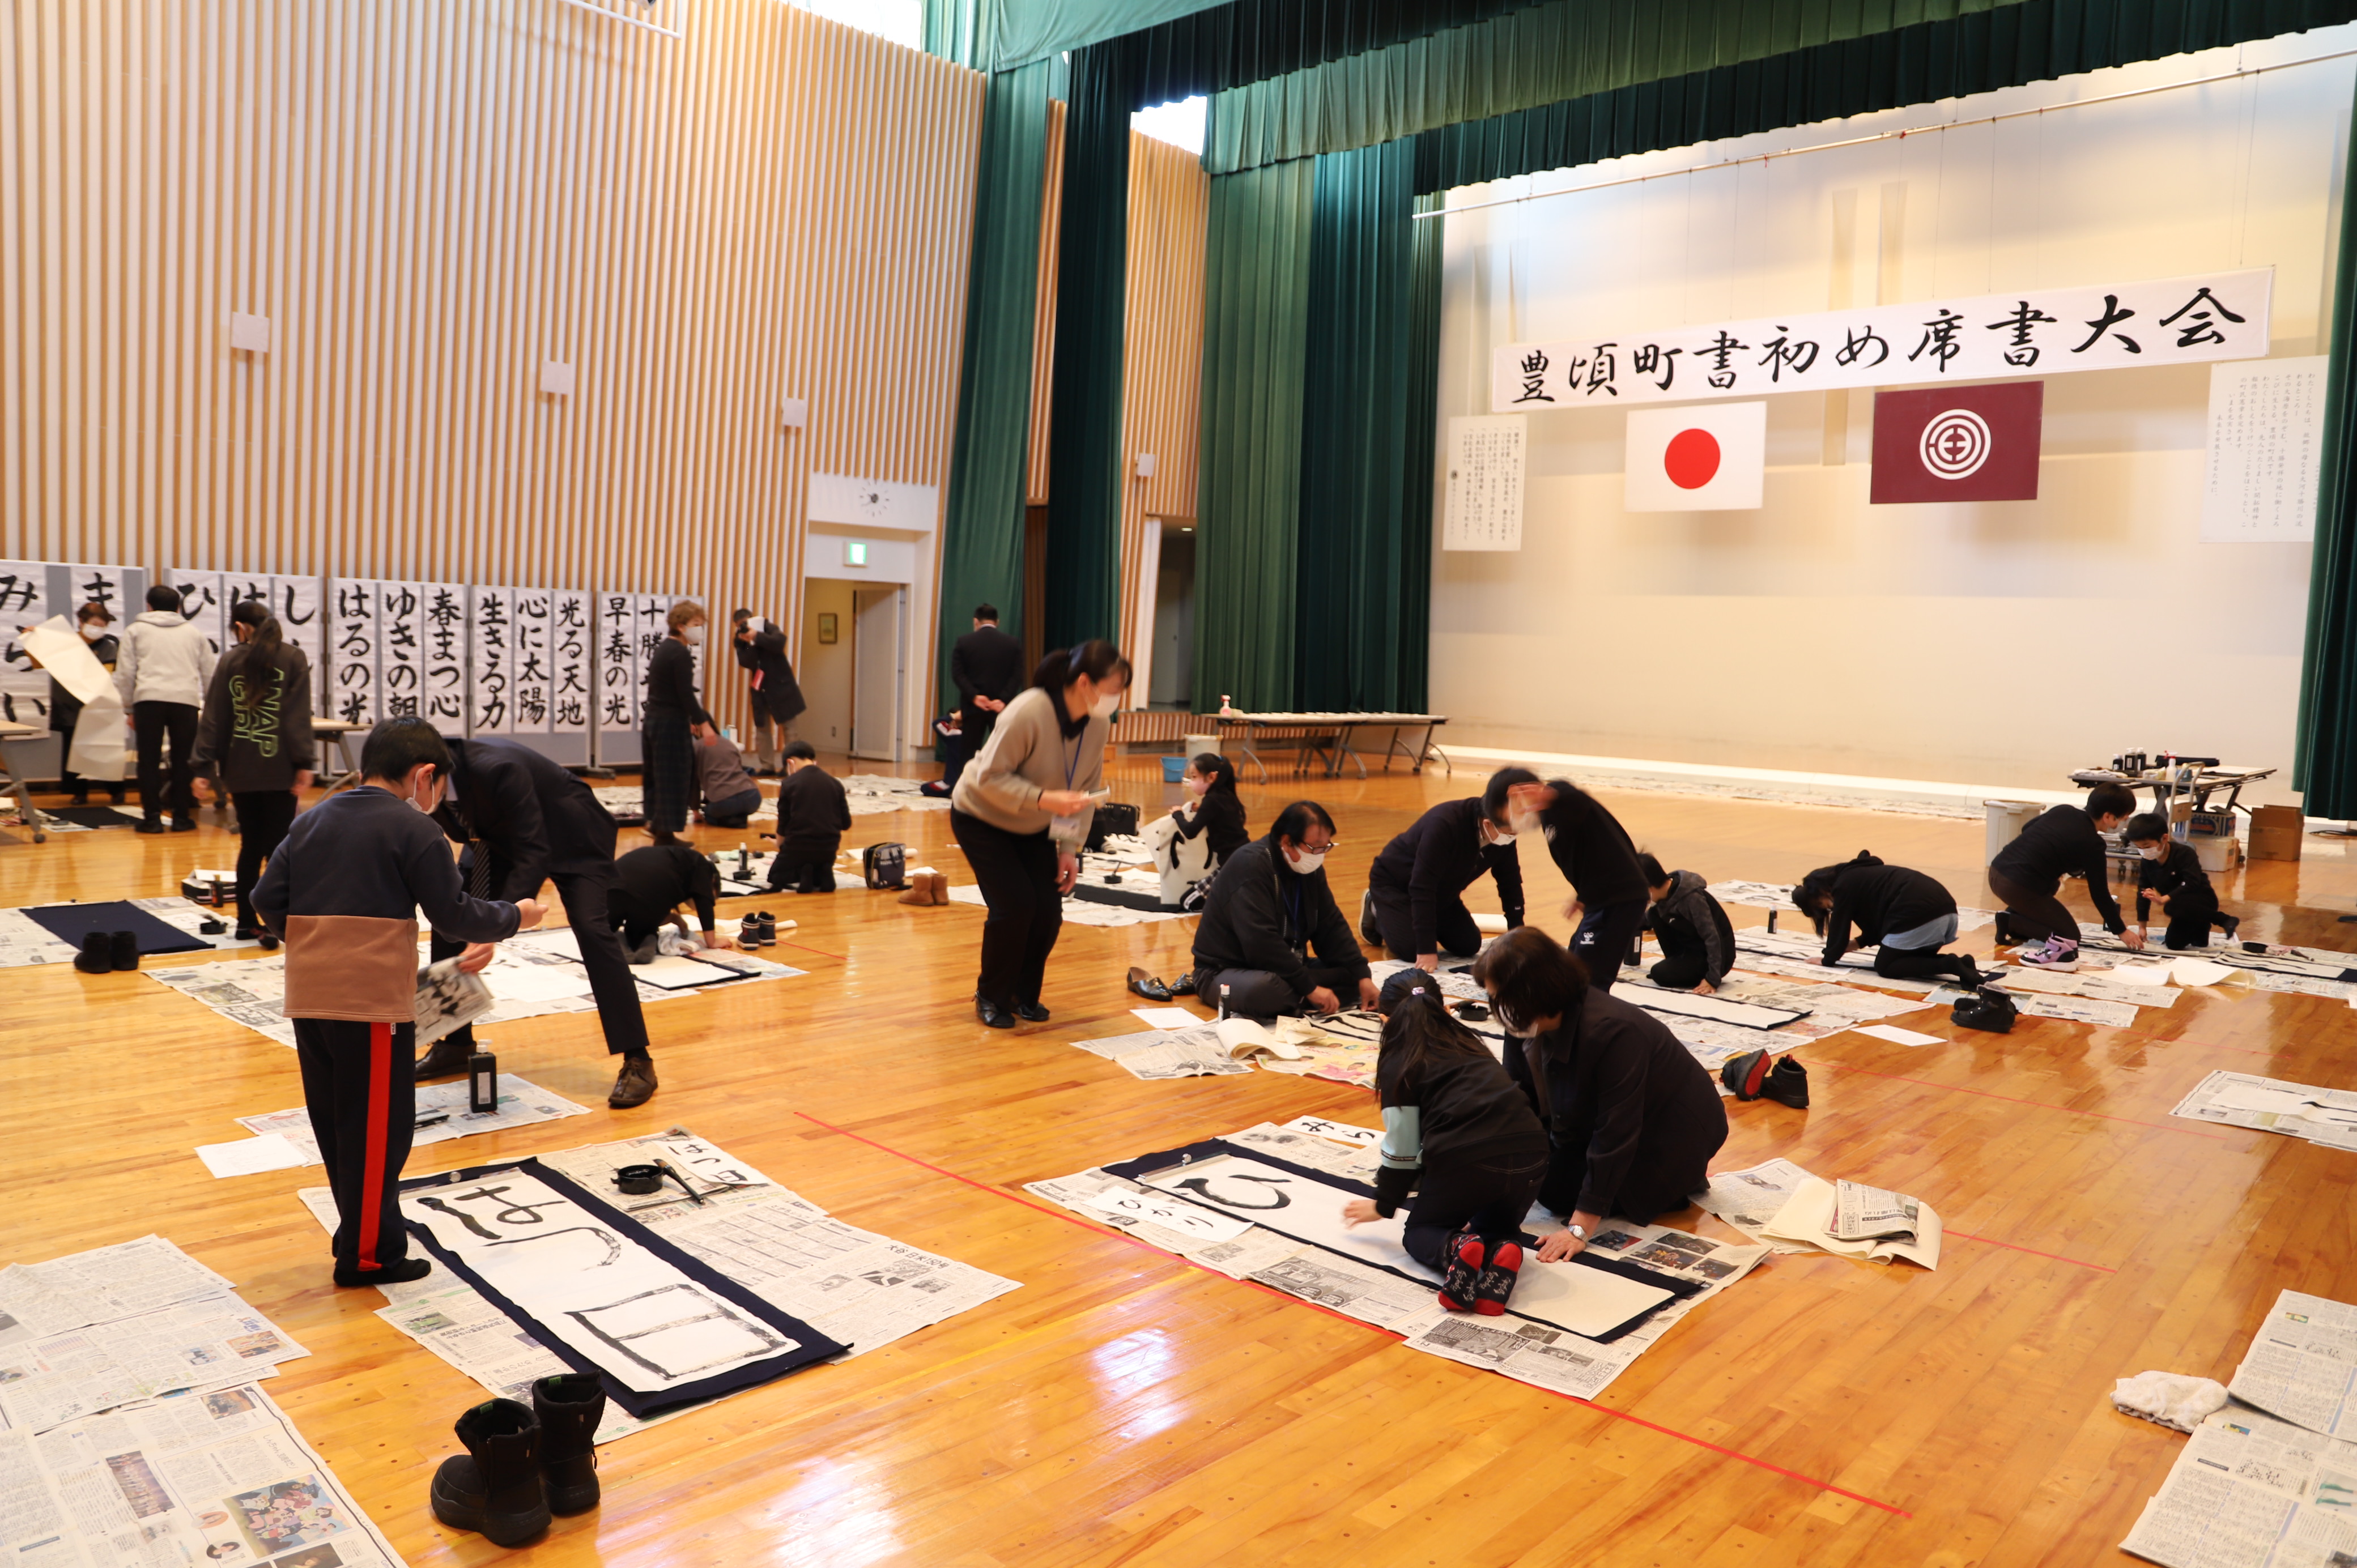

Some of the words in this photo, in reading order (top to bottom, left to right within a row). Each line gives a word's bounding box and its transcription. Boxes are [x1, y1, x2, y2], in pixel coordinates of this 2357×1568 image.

[1511, 287, 2247, 403] 豊頃町書初め席書大会
[339, 584, 372, 725] はるの光
[386, 586, 418, 718] ゆきの朝
[428, 587, 463, 718] 春まつ心
[475, 592, 508, 729] 生きる力
[518, 596, 550, 725] 心に太陽
[556, 596, 588, 726] 光る天地
[602, 596, 633, 726] 早春の光
